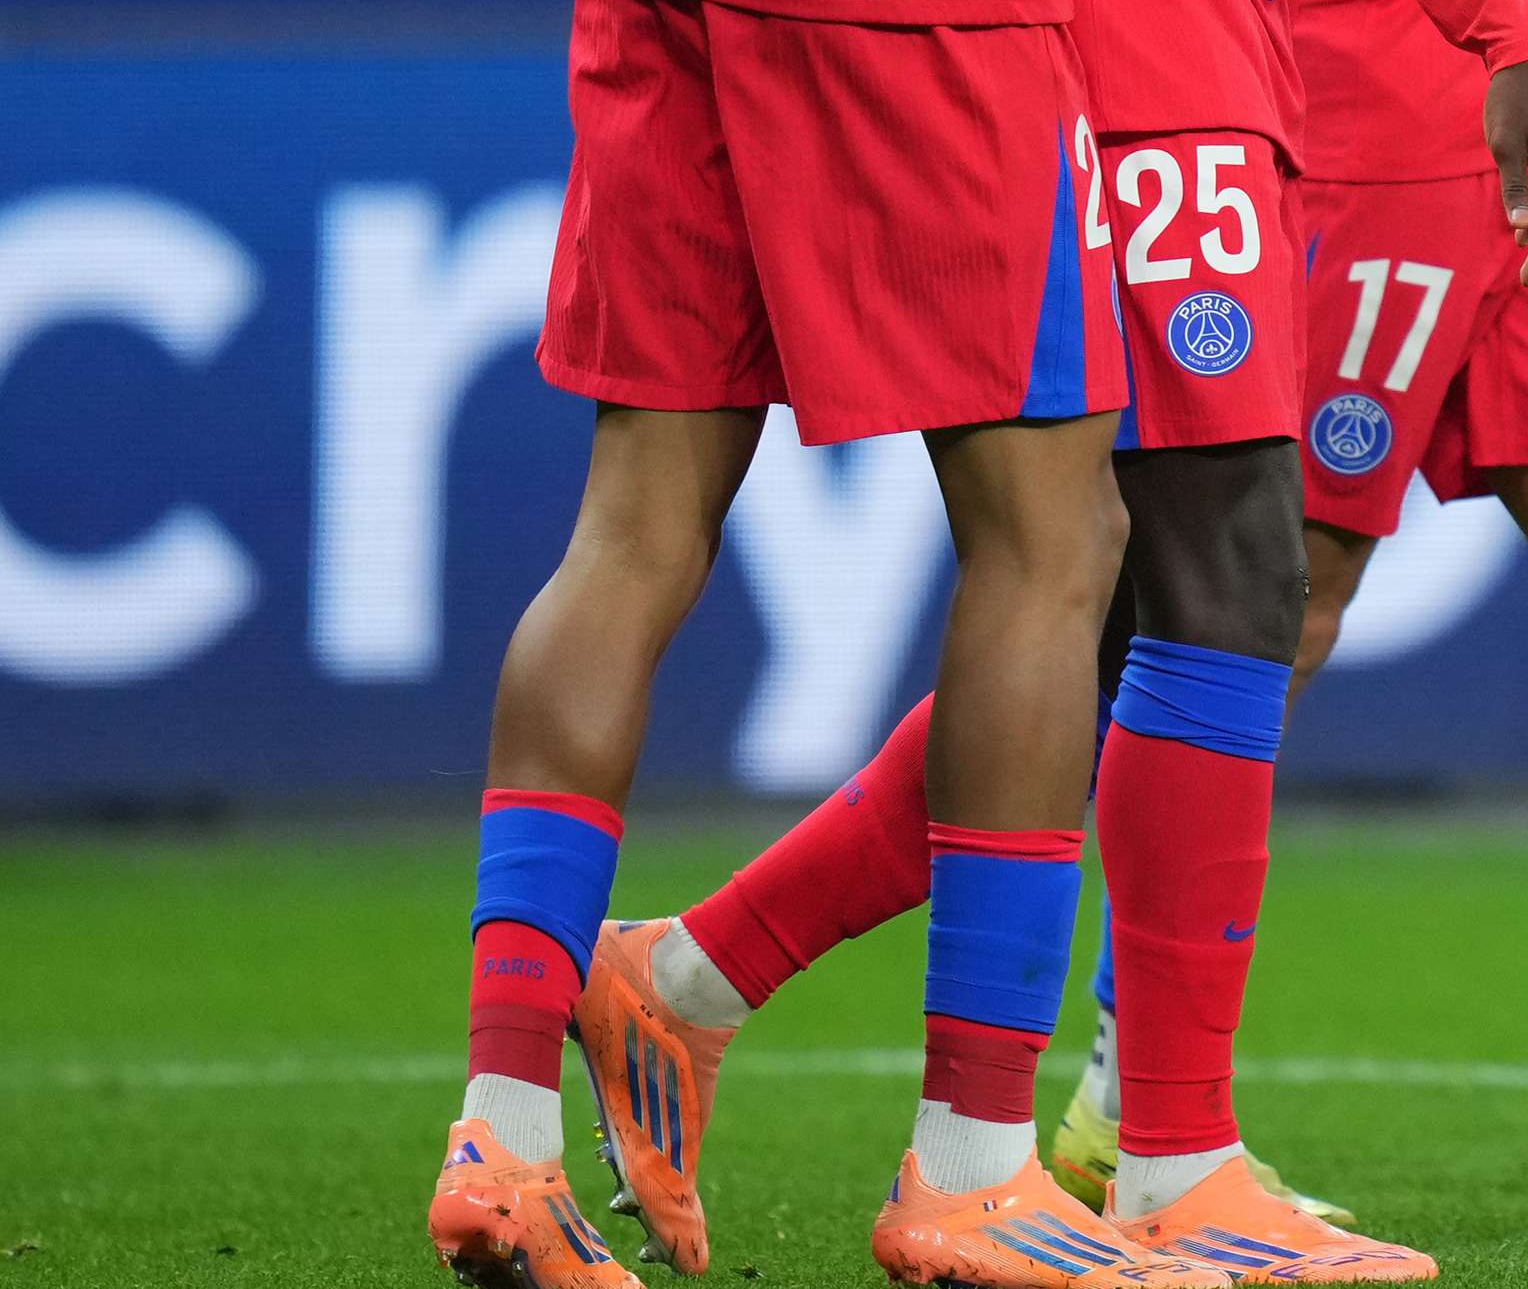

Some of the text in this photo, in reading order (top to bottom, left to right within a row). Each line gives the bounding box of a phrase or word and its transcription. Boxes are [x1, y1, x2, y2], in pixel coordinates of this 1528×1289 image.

[1075, 114, 1112, 250] 2
[1116, 145, 1260, 284] 25
[1178, 297, 1233, 320] PARIS
[1338, 258, 1454, 392] 17
[1330, 398, 1382, 424] PARIS
[482, 957, 545, 979] PARIS
